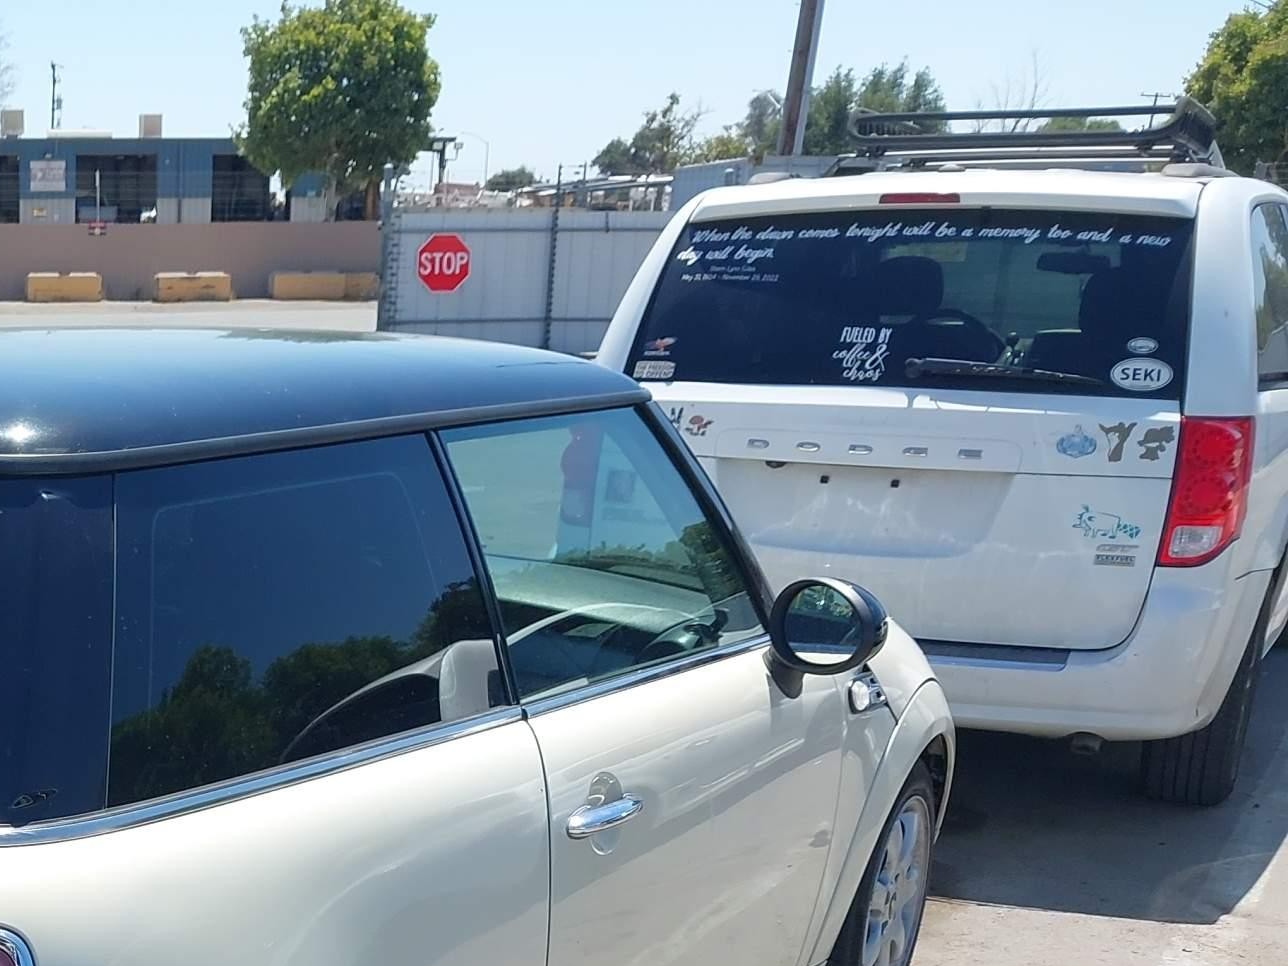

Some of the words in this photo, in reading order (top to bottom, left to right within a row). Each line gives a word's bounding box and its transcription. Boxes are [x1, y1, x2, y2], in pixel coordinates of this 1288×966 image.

[692, 227, 729, 243] When
[731, 225, 752, 241] the
[755, 226, 793, 240] dawn
[798, 228, 840, 240] comes
[846, 222, 901, 242] tonight
[902, 222, 931, 236] will
[935, 222, 957, 238] be
[962, 227, 973, 237] a
[978, 226, 1041, 244] memory
[1047, 224, 1073, 239] too
[1076, 227, 1113, 242] and
[1119, 233, 1133, 244] a
[1136, 234, 1172, 246] new
[420, 252, 468, 275] STOP
[677, 246, 704, 265] day
[704, 245, 729, 260] will
[840, 326, 876, 343] FUELED
[877, 327, 892, 343] BY
[832, 343, 872, 367] coffee
[865, 343, 890, 371] &
[843, 361, 882, 381] chaos
[1120, 367, 1161, 382] SEKI
[747, 438, 984, 459] DODGE
